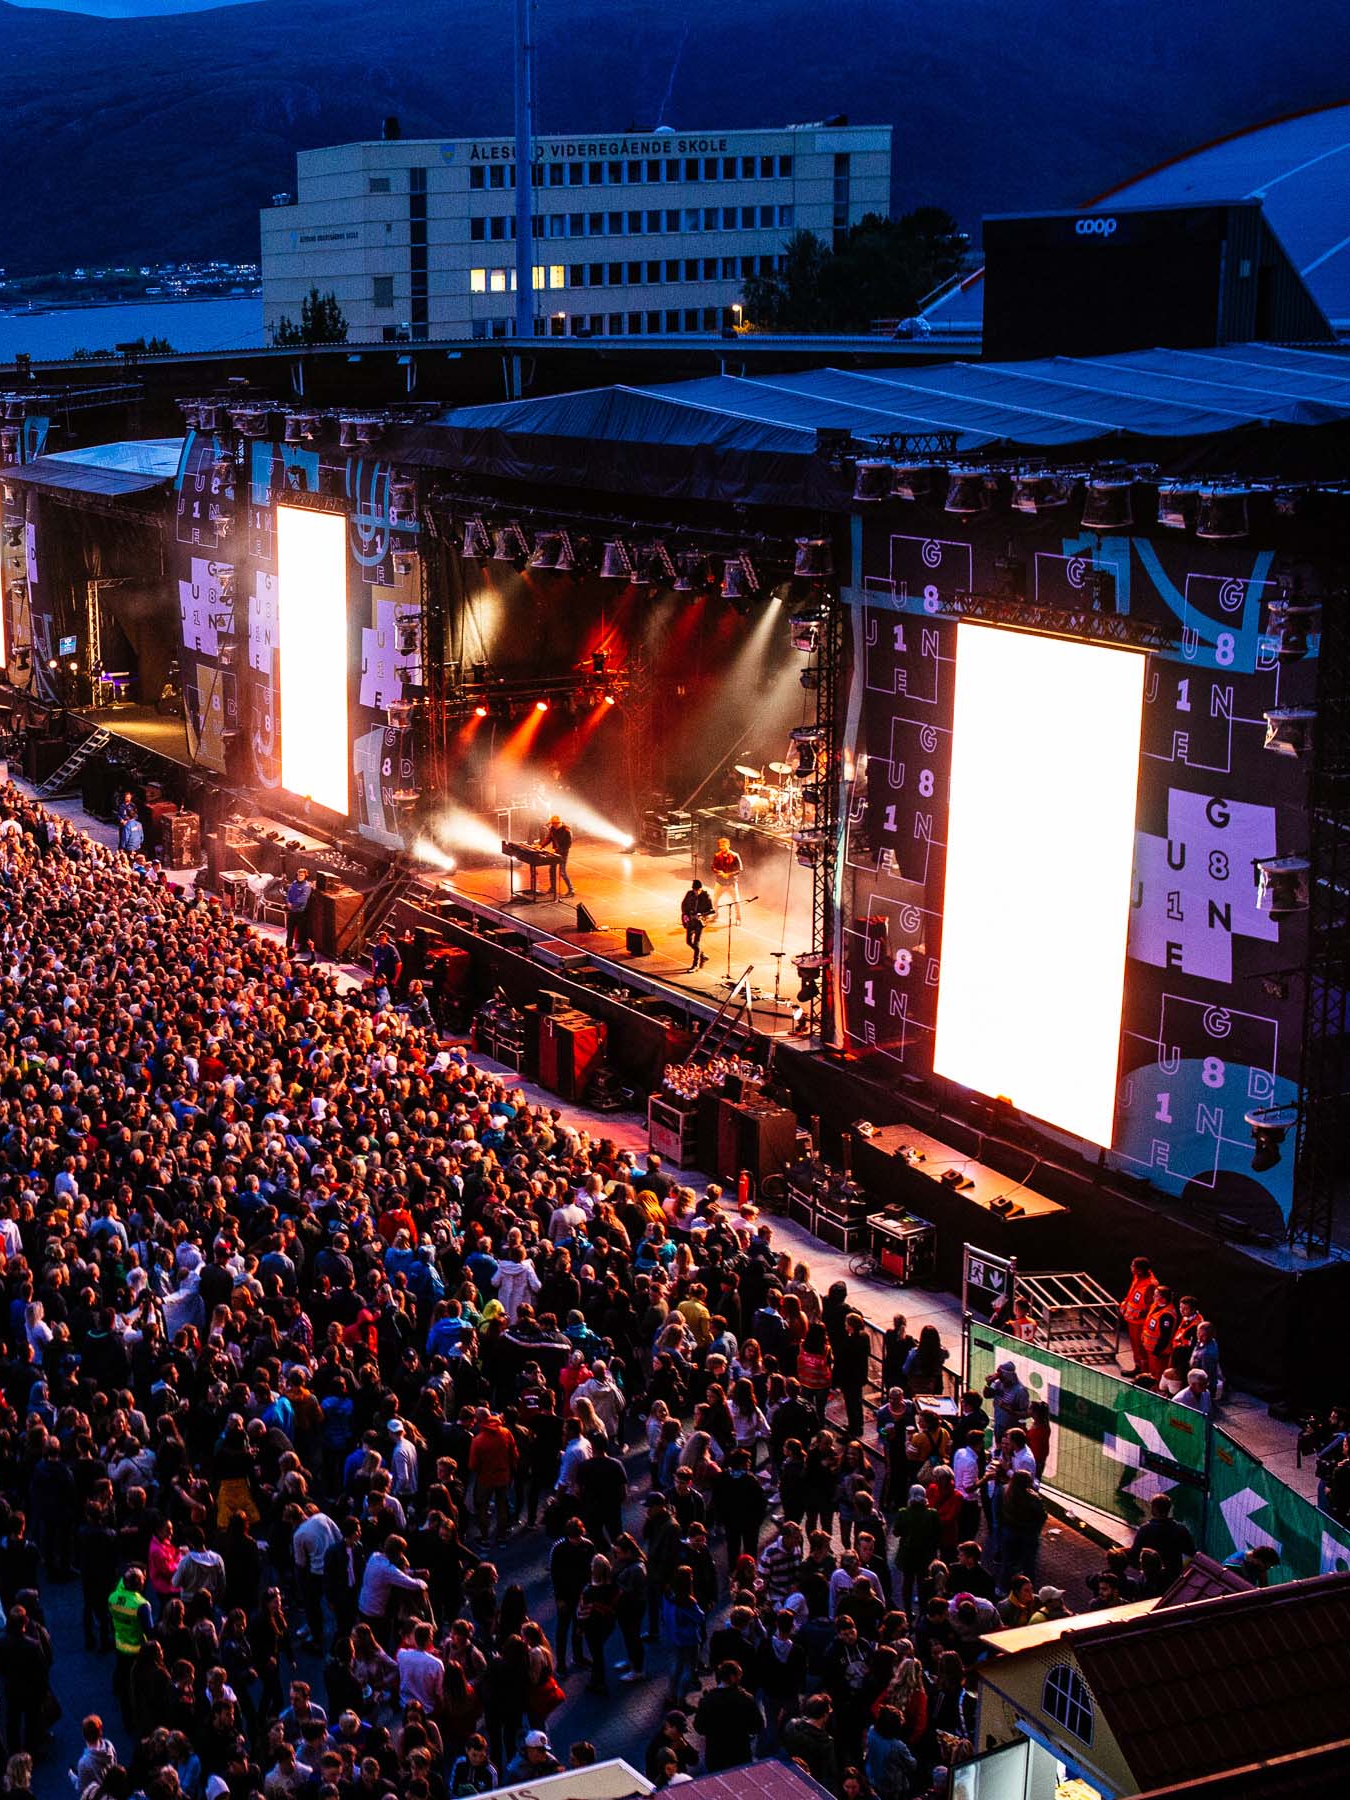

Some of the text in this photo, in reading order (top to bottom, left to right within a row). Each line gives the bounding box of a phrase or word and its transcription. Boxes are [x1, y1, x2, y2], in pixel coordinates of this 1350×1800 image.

[471, 138, 728, 161] ÅLESD VIDEREGÅENDE SKOLE
[1076, 218, 1116, 237] coop
